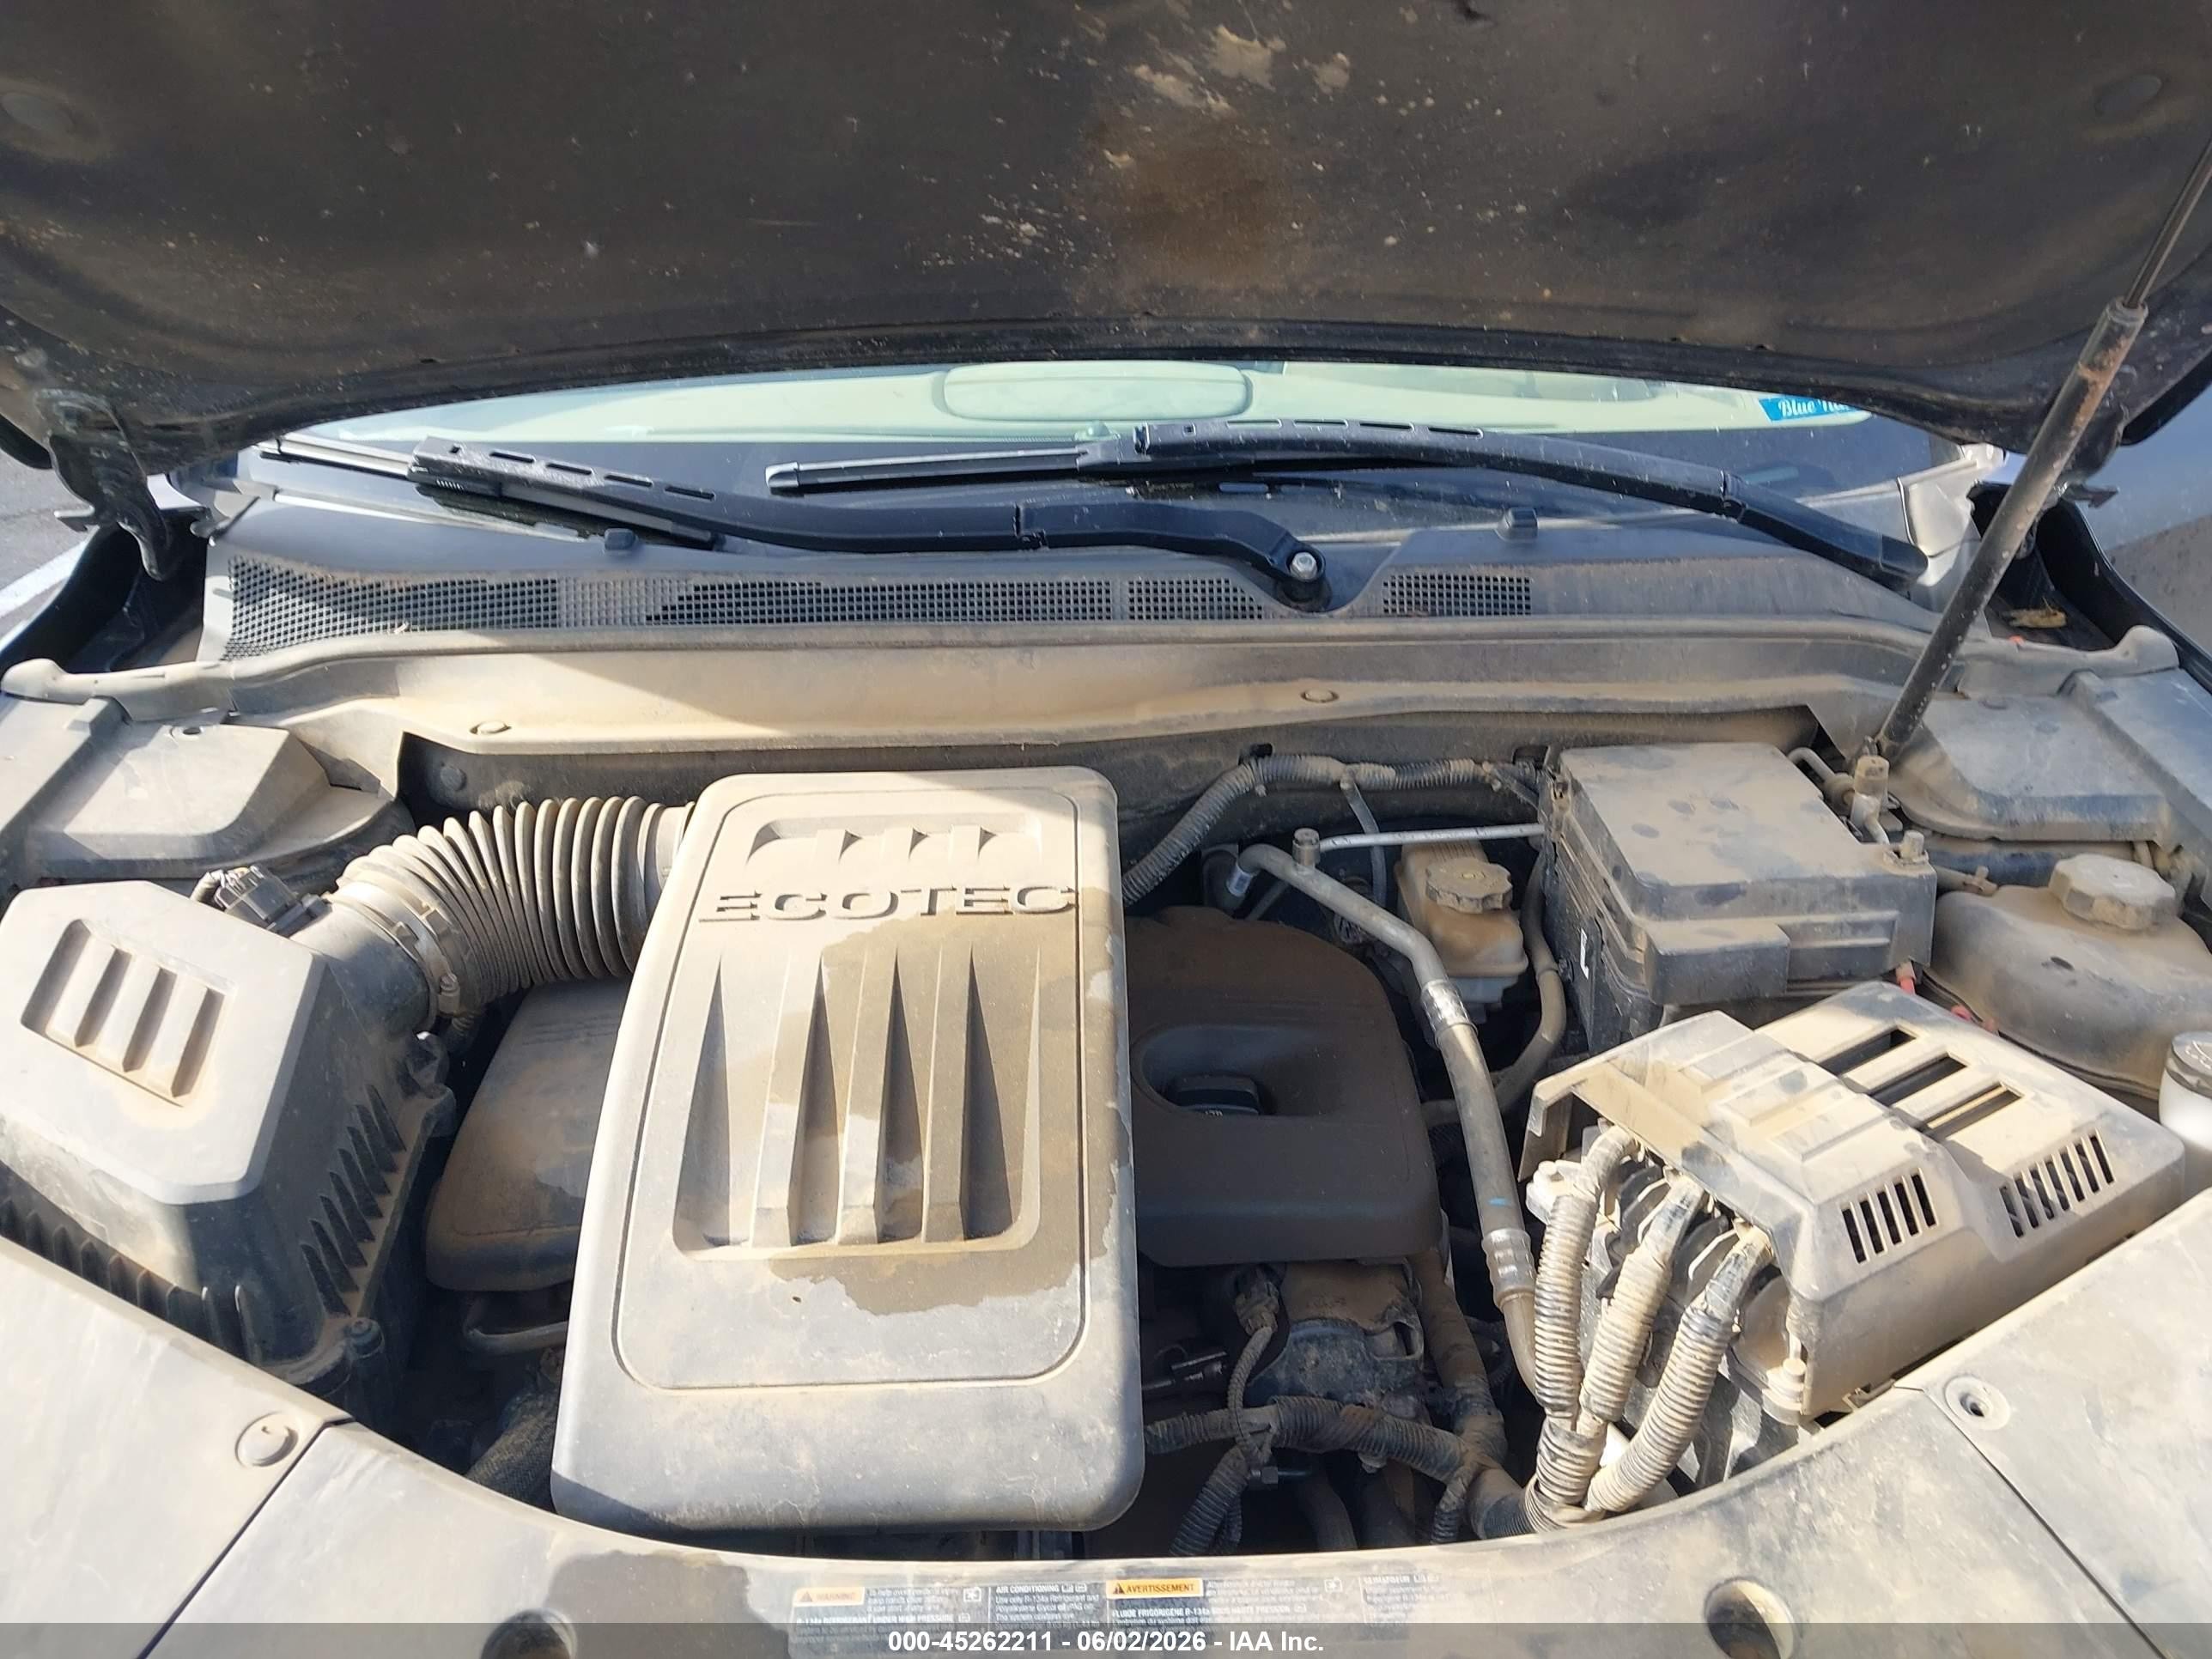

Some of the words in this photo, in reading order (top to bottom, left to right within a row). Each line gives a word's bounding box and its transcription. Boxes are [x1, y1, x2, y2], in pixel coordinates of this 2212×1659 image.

[1778, 398, 1816, 417] Blue
[699, 884, 1076, 922] ECOTEC
[1010, 1584, 1060, 1594] CONDITIONING
[1127, 1583, 1194, 1594] AVERTISSEMENT
